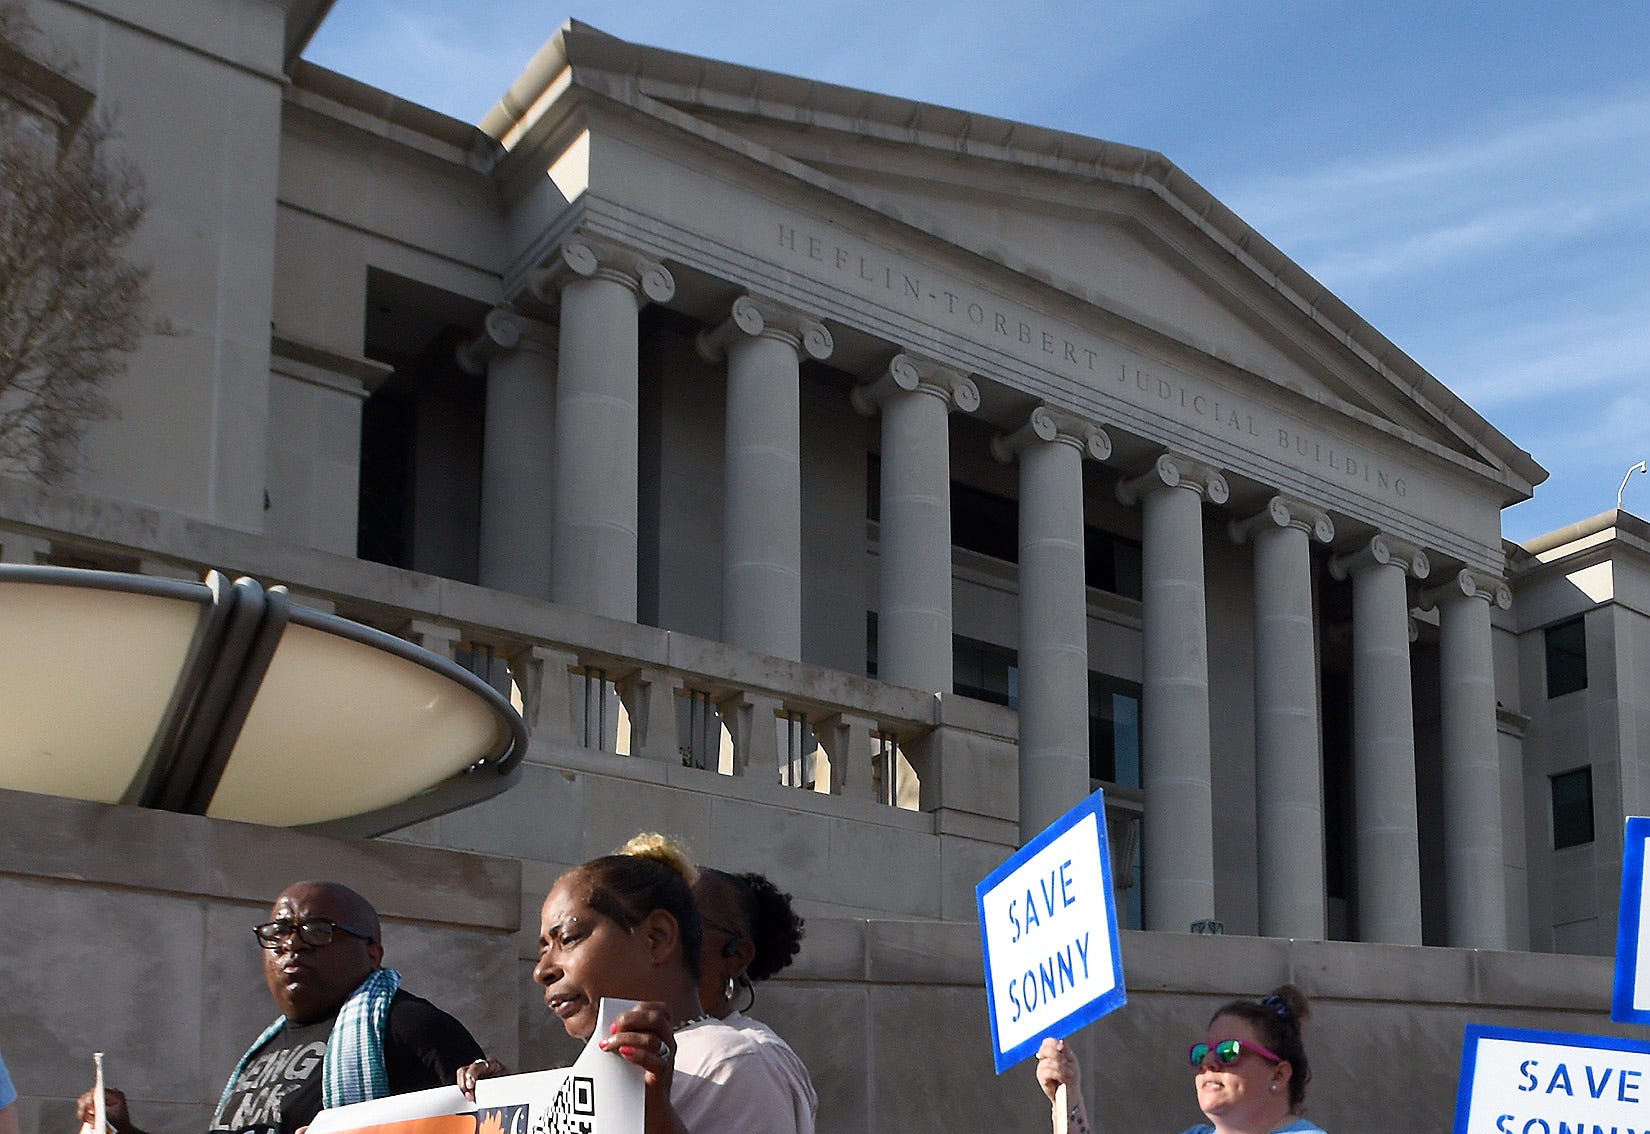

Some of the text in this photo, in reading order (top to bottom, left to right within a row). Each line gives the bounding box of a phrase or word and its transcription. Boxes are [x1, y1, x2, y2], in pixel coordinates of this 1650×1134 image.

[778, 223, 1408, 498] HEFLIN-TORBERT JUDICIAL BUILDING
[1009, 859, 1076, 943] SAVE
[1009, 932, 1089, 1023] SONNY
[235, 1041, 326, 1092] EING
[1518, 1059, 1643, 1104] SAVE
[208, 1084, 301, 1131] LACK
